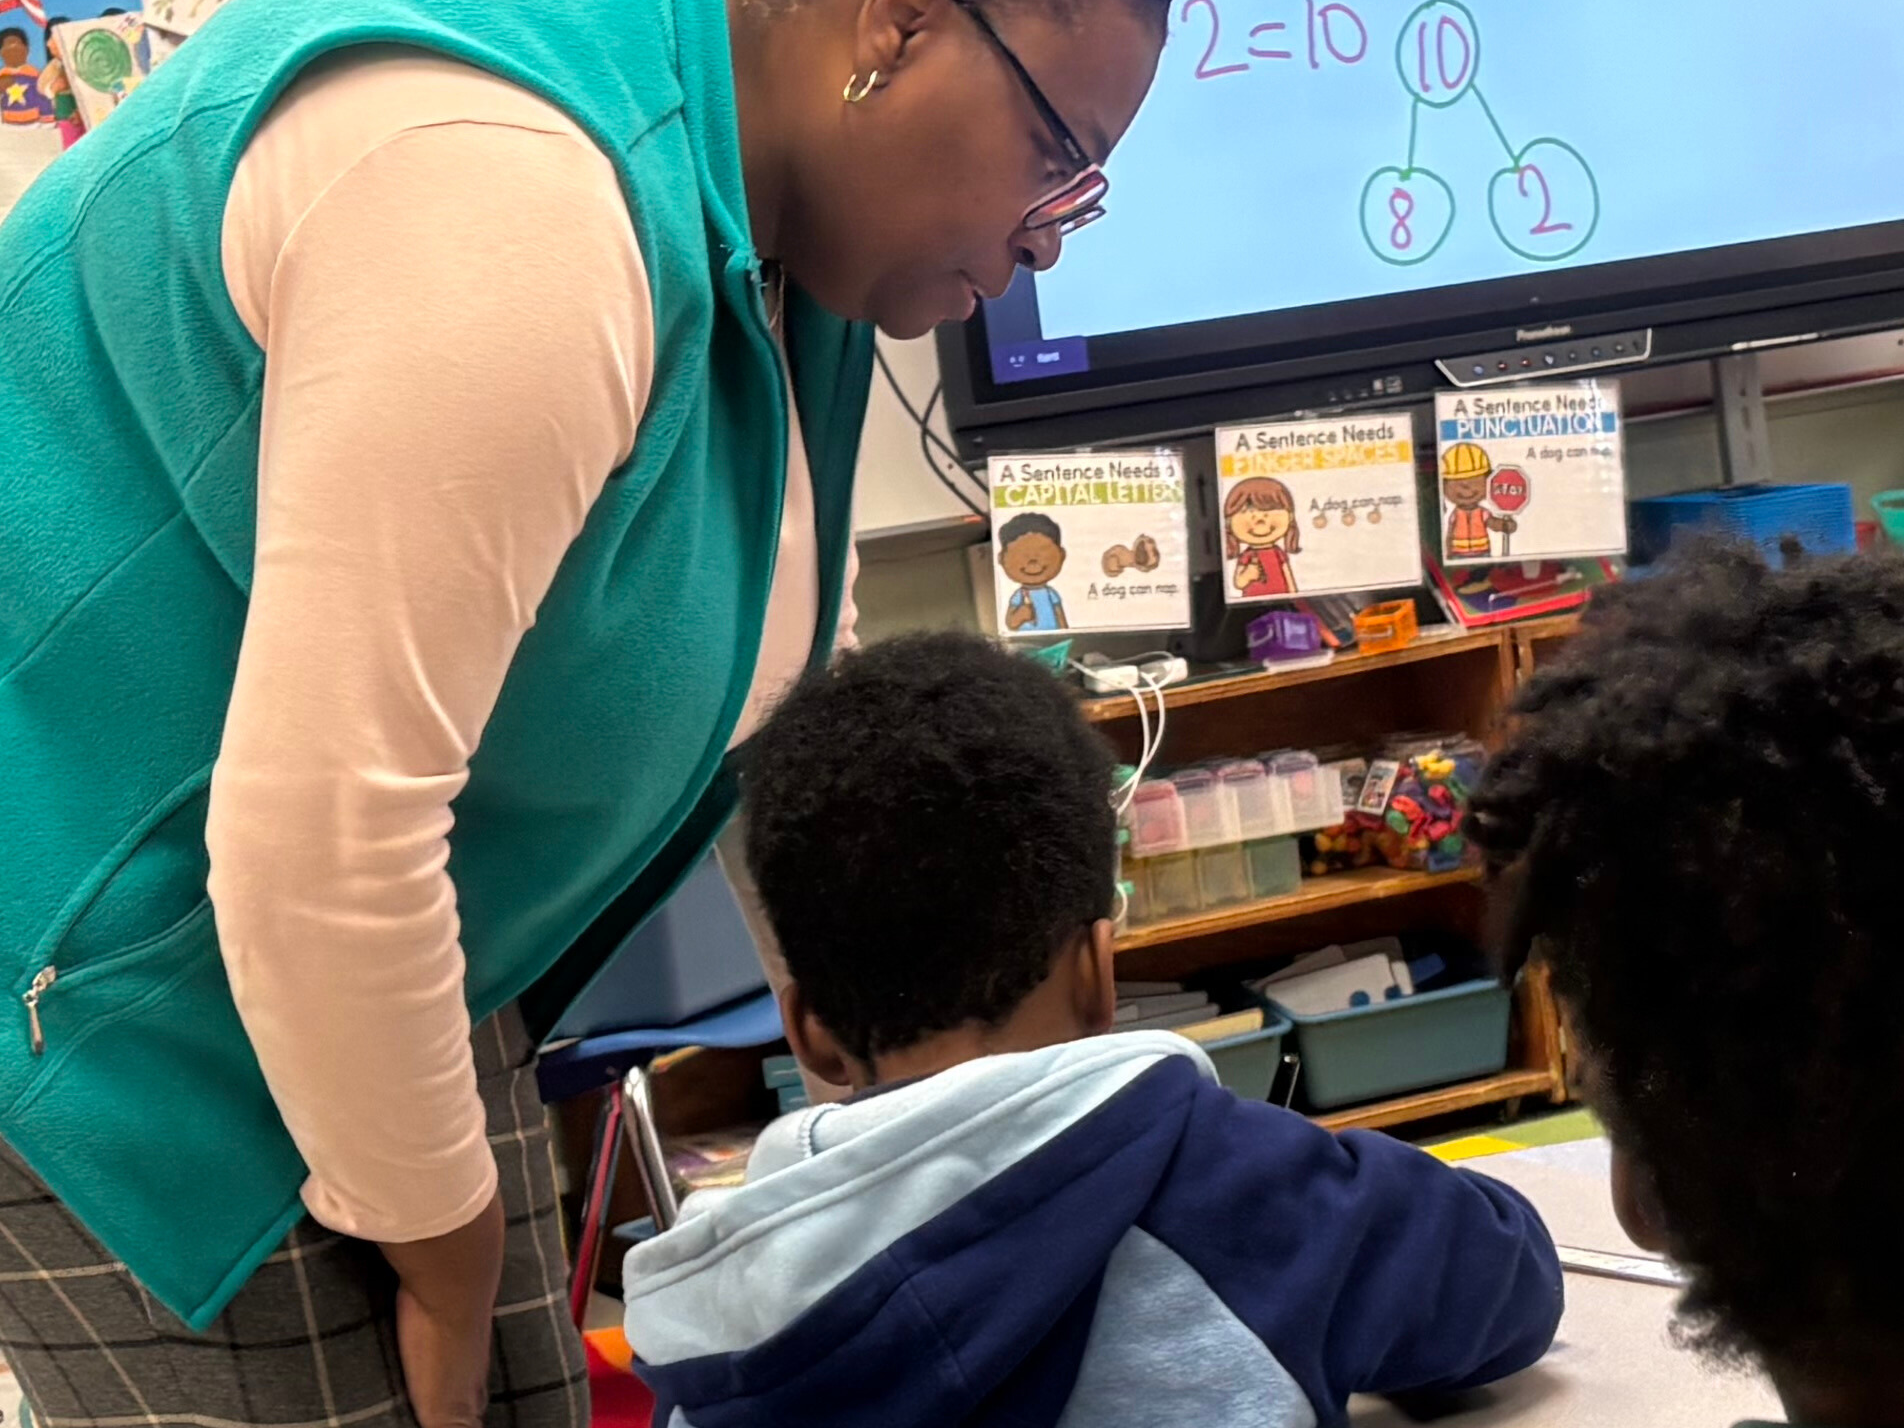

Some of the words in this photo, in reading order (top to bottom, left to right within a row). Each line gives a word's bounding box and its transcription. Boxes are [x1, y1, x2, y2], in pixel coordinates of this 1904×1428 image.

[1416, 15, 1471, 93] 10
[1387, 187, 1412, 250] 8
[1516, 166, 1573, 234] 2
[1235, 432, 1251, 452] A
[1257, 429, 1337, 450] Sentence
[1342, 423, 1394, 442] Needs
